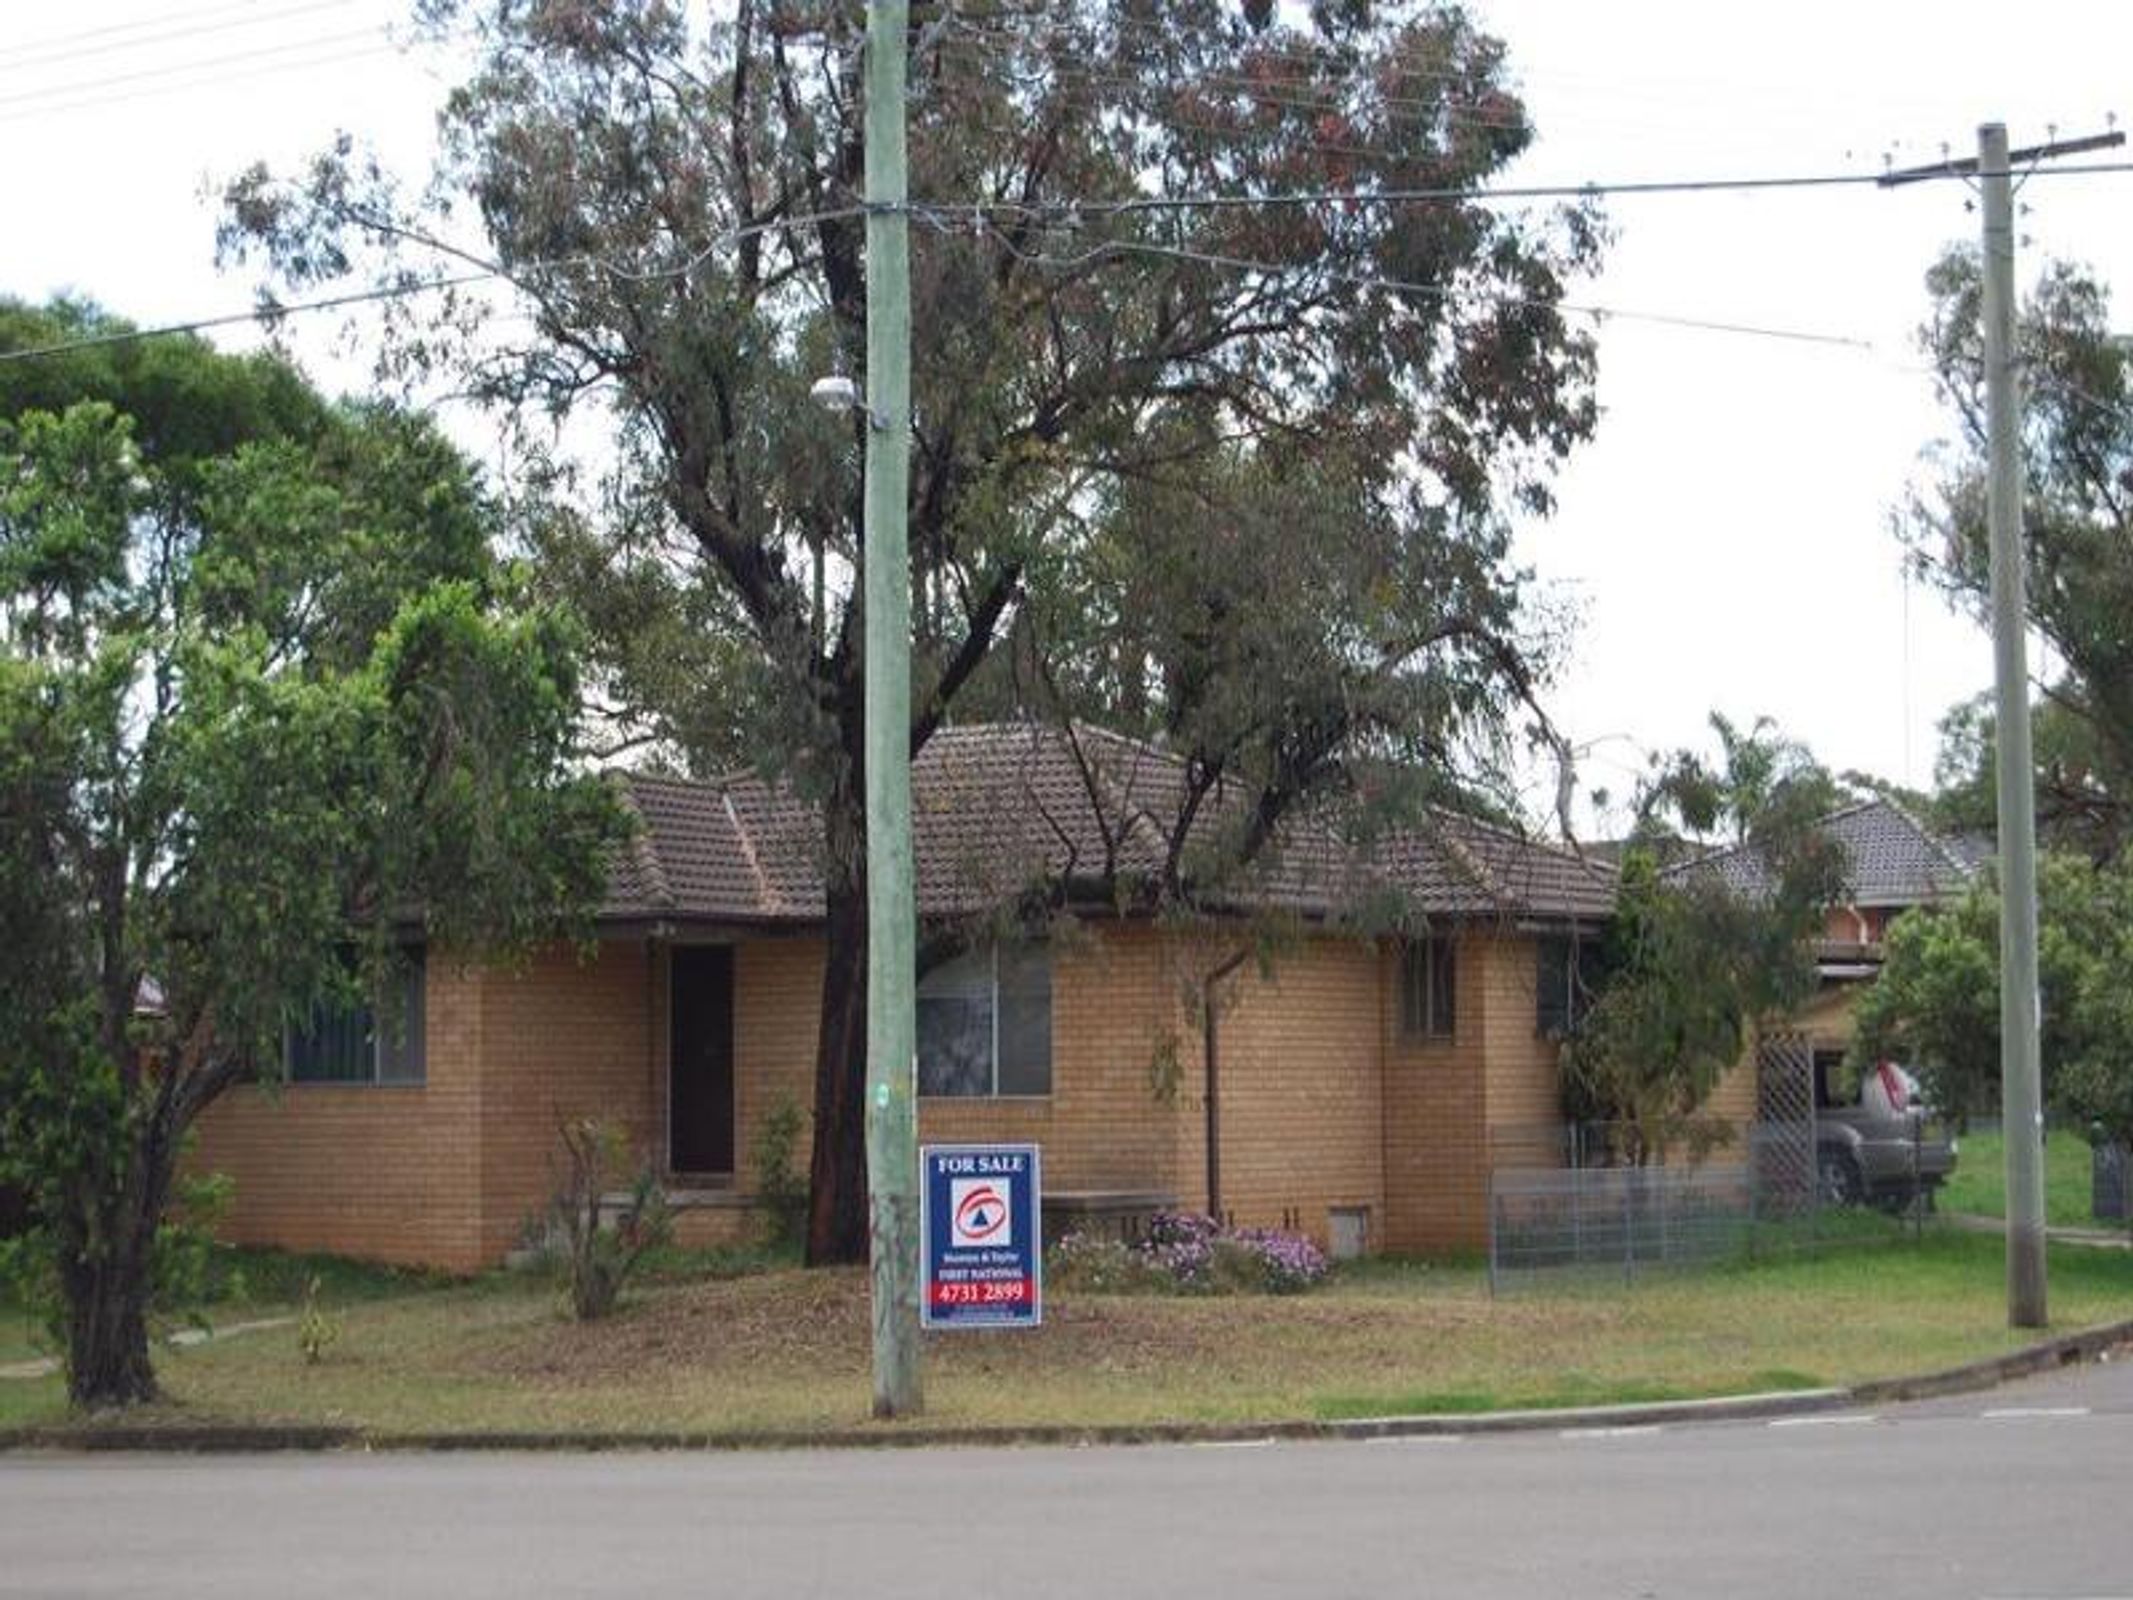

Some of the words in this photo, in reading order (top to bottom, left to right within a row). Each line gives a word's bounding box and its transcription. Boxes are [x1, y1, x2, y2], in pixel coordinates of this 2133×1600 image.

[938, 1156, 976, 1173] FOR
[979, 1156, 1023, 1173] SALE
[939, 1283, 978, 1303] 4731
[983, 1281, 1023, 1301] 2899
